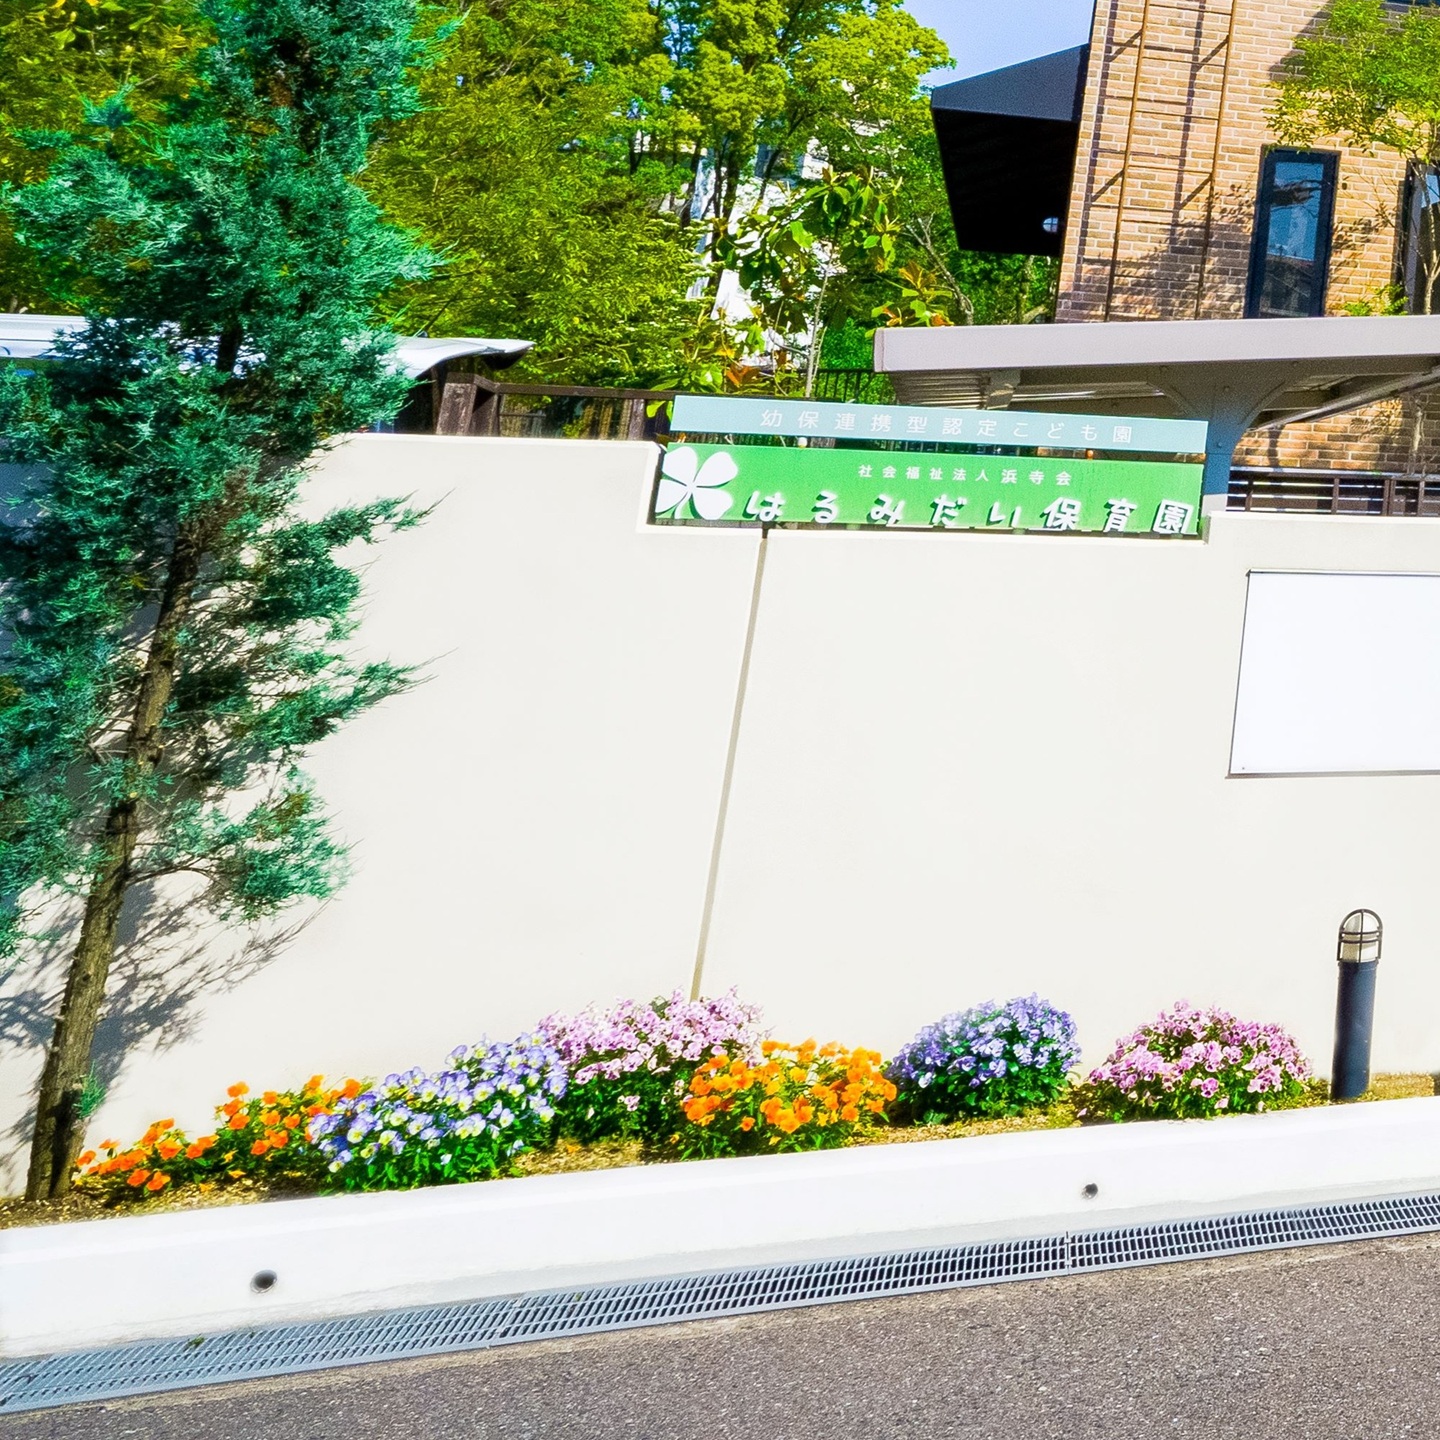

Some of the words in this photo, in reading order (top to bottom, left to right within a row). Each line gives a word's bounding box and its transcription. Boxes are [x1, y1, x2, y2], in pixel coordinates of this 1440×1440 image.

[760, 409, 1133, 444] 幼保連携型認定こども園
[857, 464, 1073, 487] 社会福祉法人浜寺会
[744, 490, 1195, 534] はるみだい保育園
